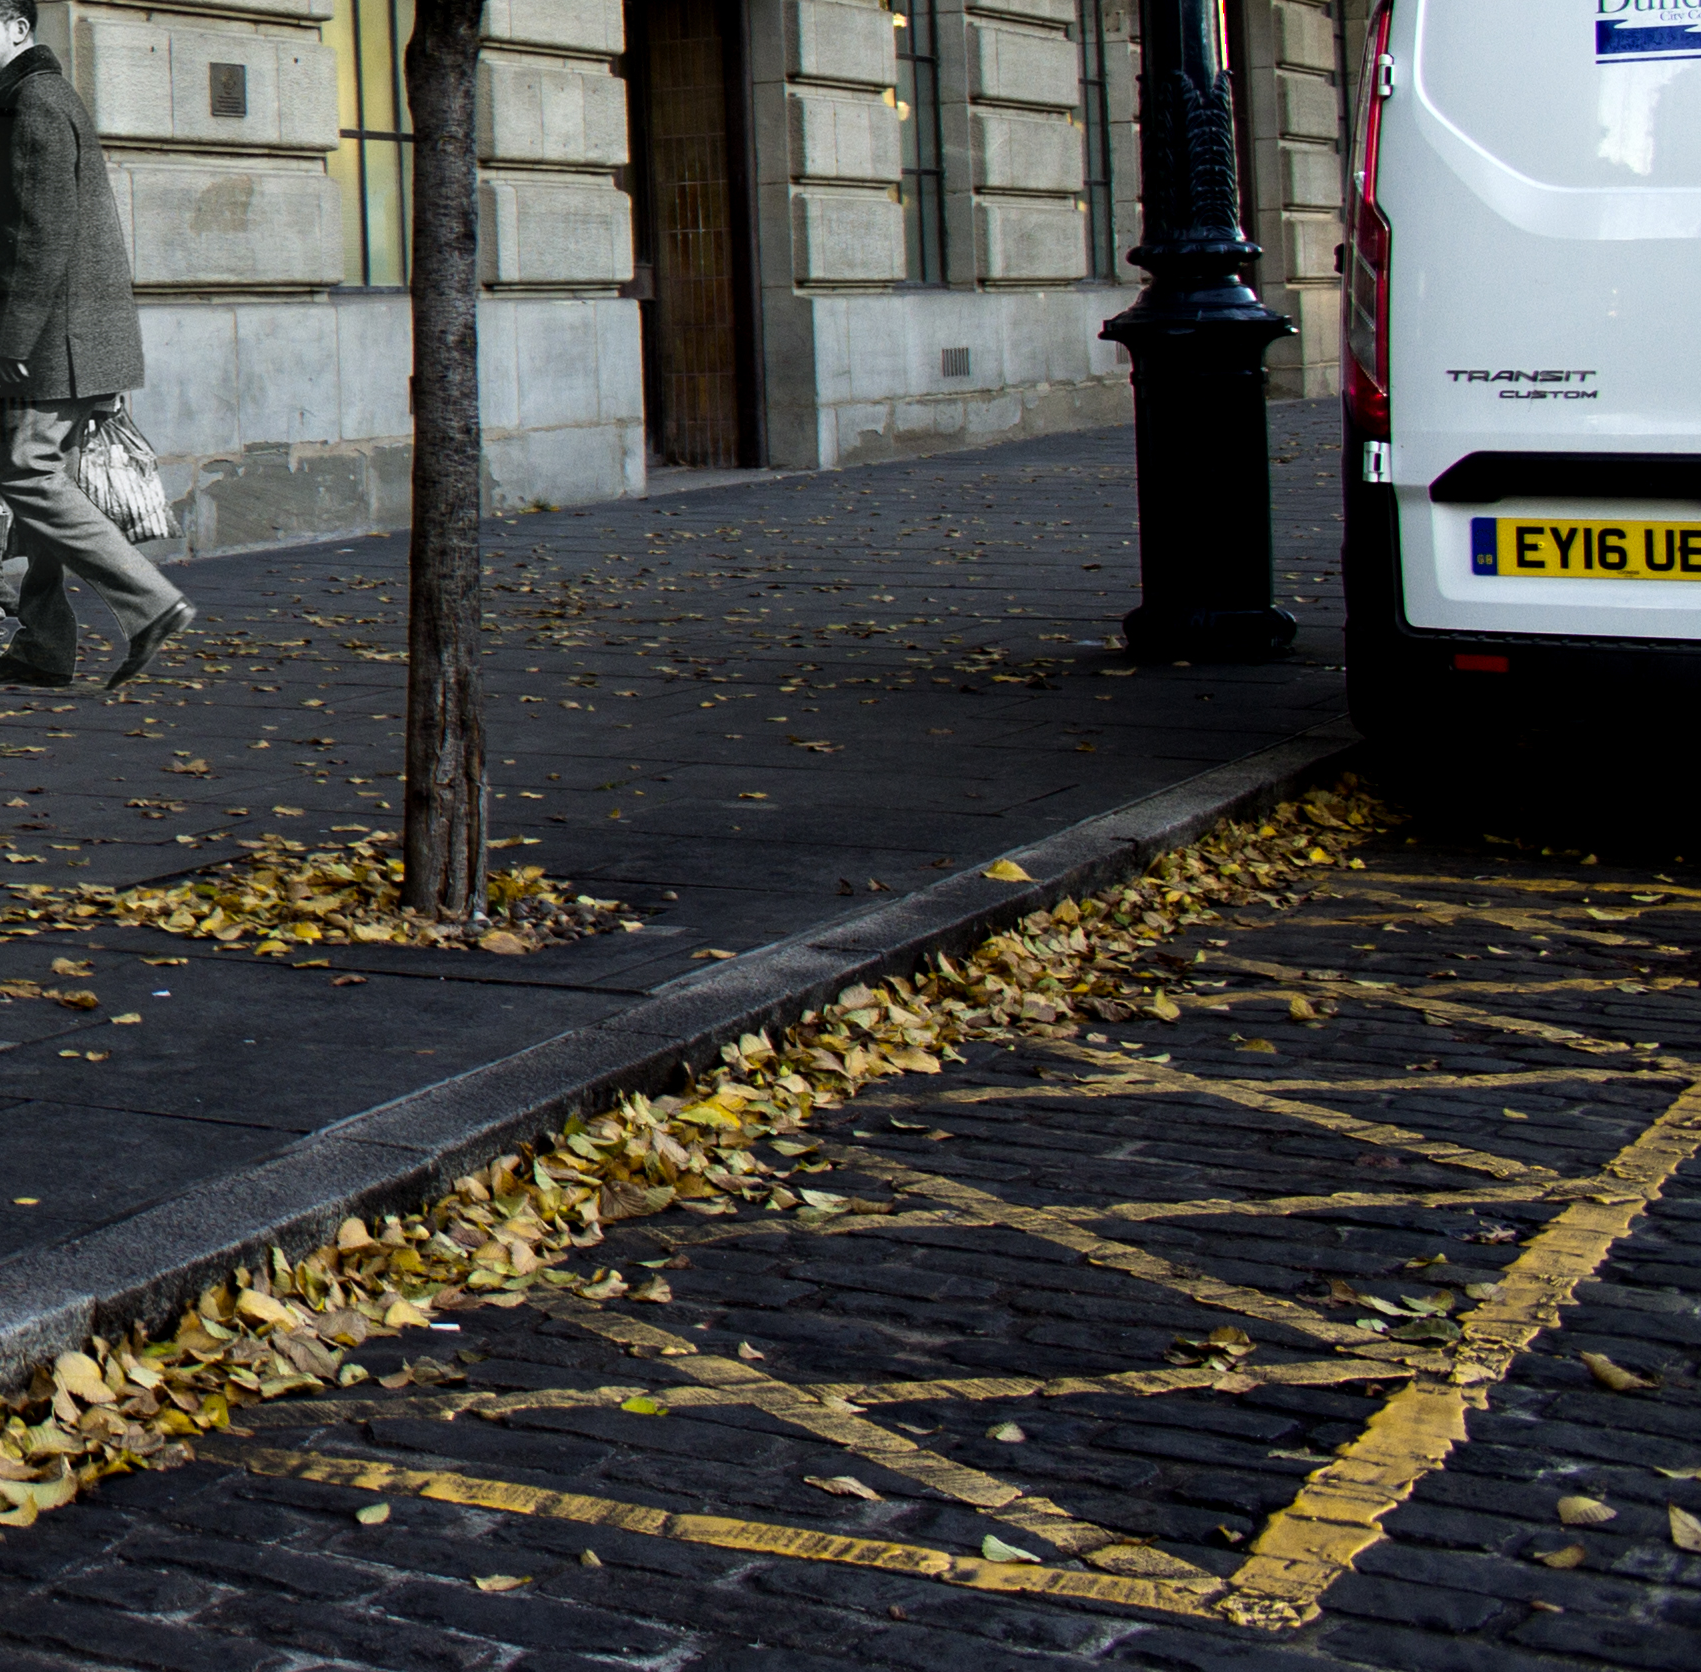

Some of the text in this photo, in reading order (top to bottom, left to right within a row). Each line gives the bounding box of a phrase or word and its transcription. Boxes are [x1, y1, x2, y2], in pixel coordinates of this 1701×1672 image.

[1659, 10, 1686, 22] City
[1446, 370, 1596, 383] TRANSIT
[1499, 390, 1598, 400] CUSTOM
[1516, 526, 1628, 571] EY16
